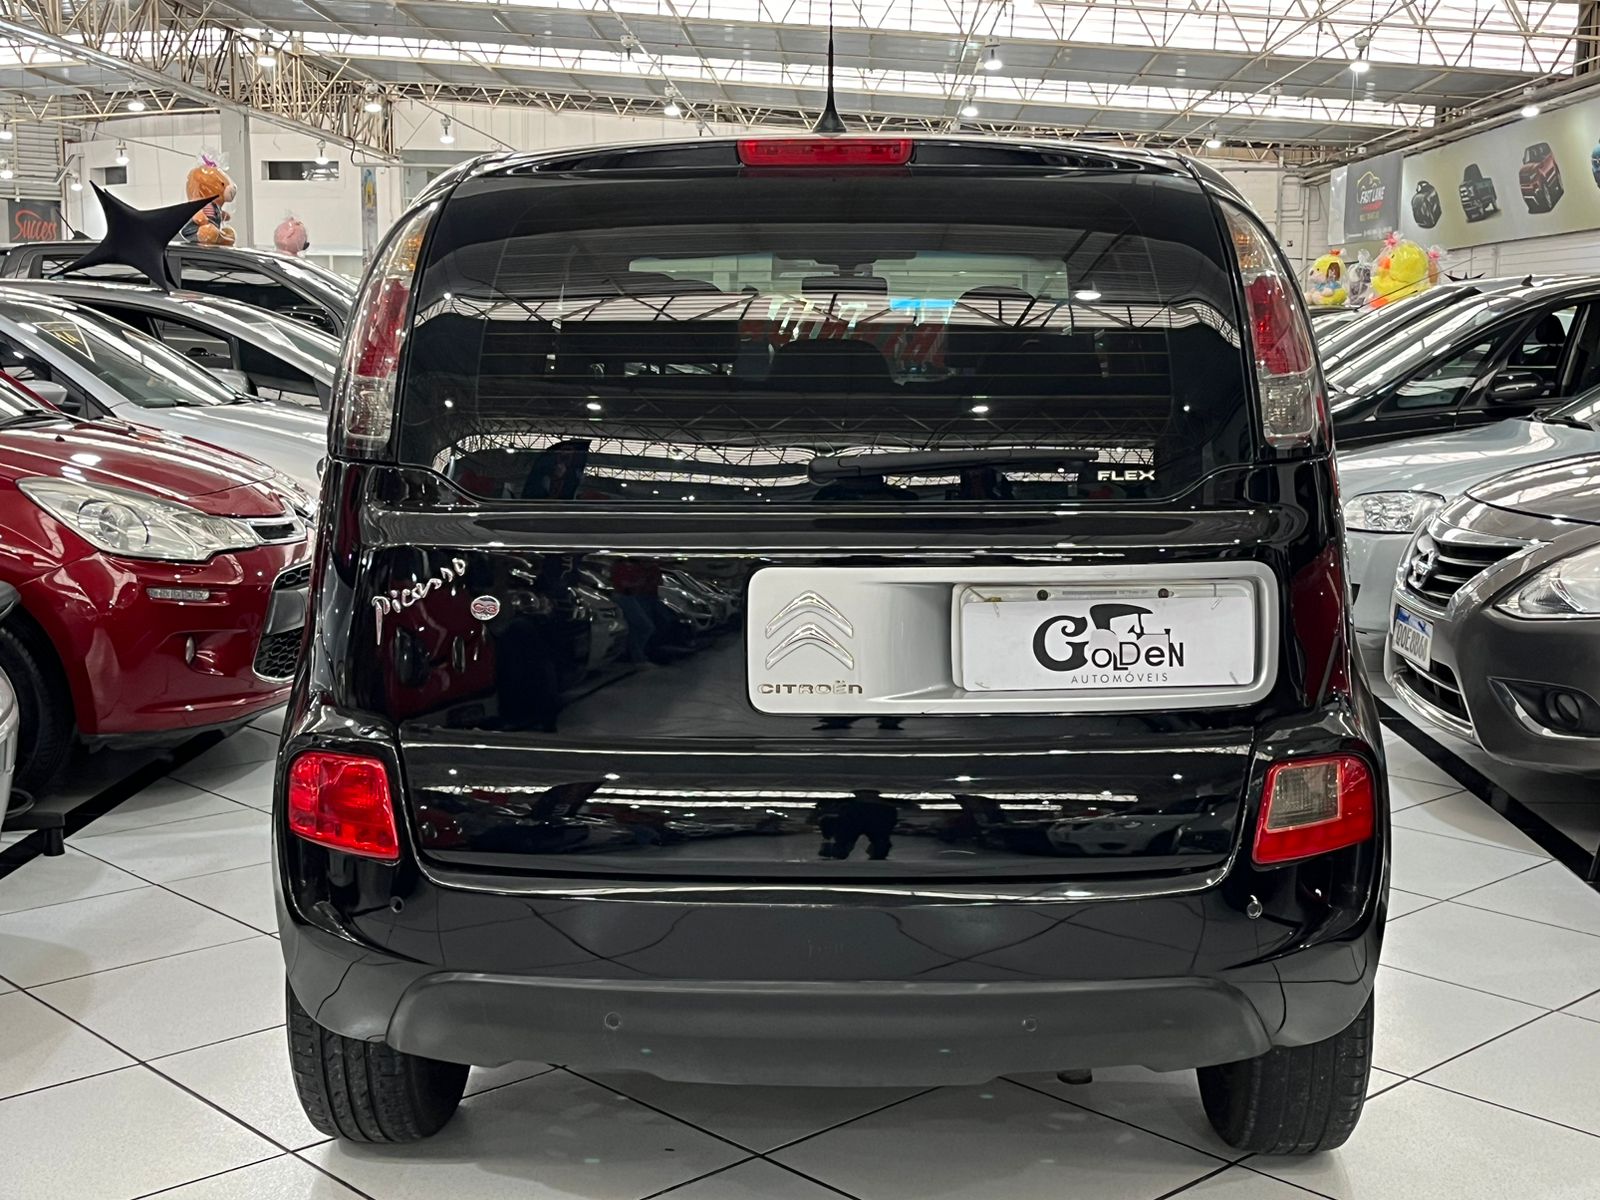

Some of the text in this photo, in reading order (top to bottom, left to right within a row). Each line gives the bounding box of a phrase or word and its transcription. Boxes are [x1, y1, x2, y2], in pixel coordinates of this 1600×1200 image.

[11, 208, 57, 241] Success
[1097, 470, 1155, 481] FLEX
[1071, 671, 1168, 684] AUTOMÓVEIS
